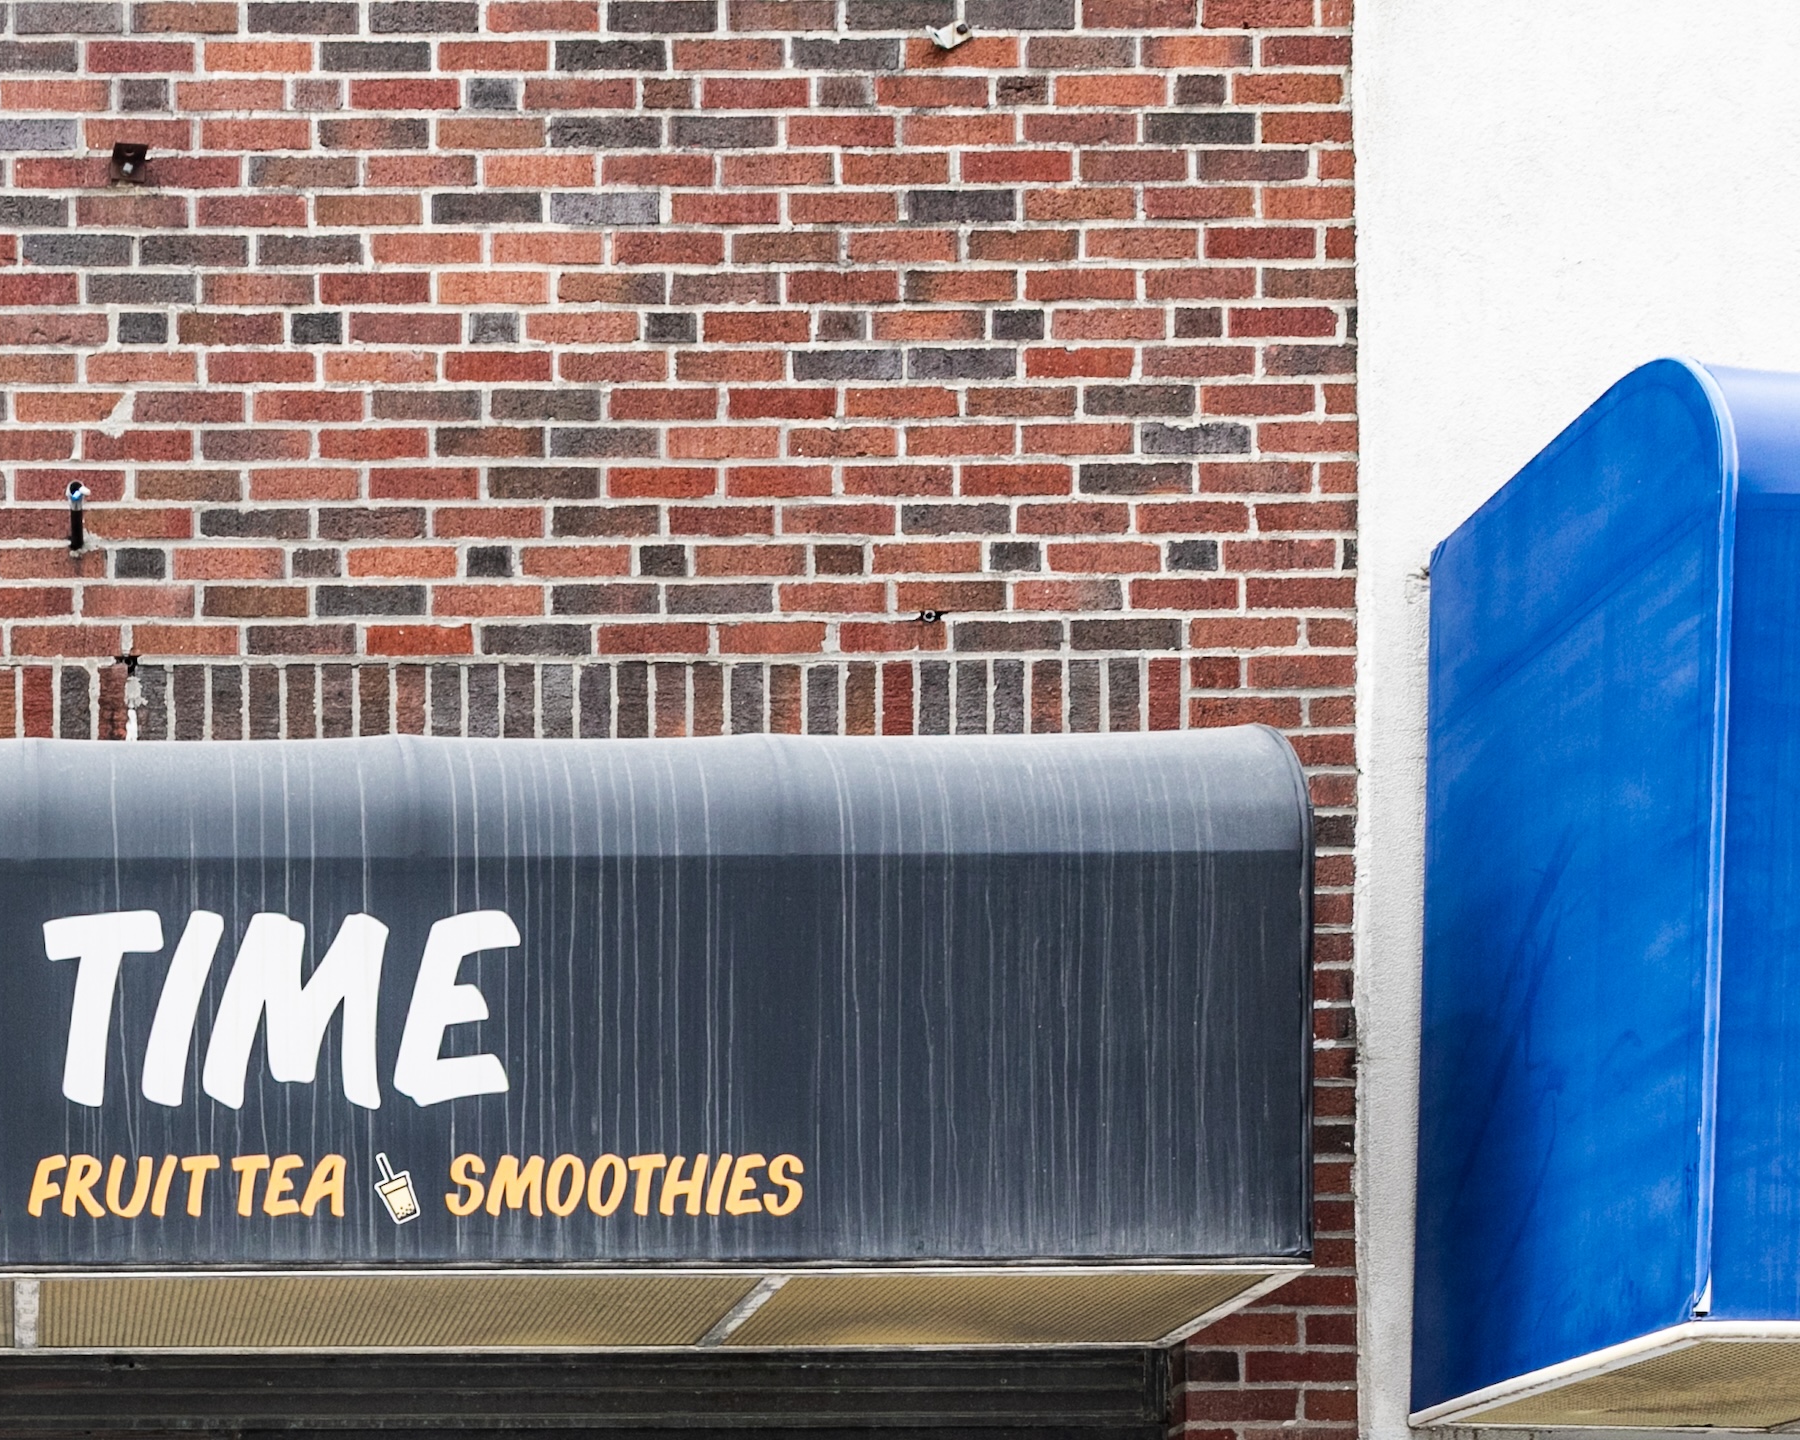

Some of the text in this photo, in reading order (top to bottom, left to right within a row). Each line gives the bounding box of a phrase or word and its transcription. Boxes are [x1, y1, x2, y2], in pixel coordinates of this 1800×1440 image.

[43, 910, 522, 1110] TIME
[27, 1154, 220, 1219] FRUIT
[231, 1155, 346, 1219] TEA
[445, 1154, 806, 1218] SMOOTHIES
